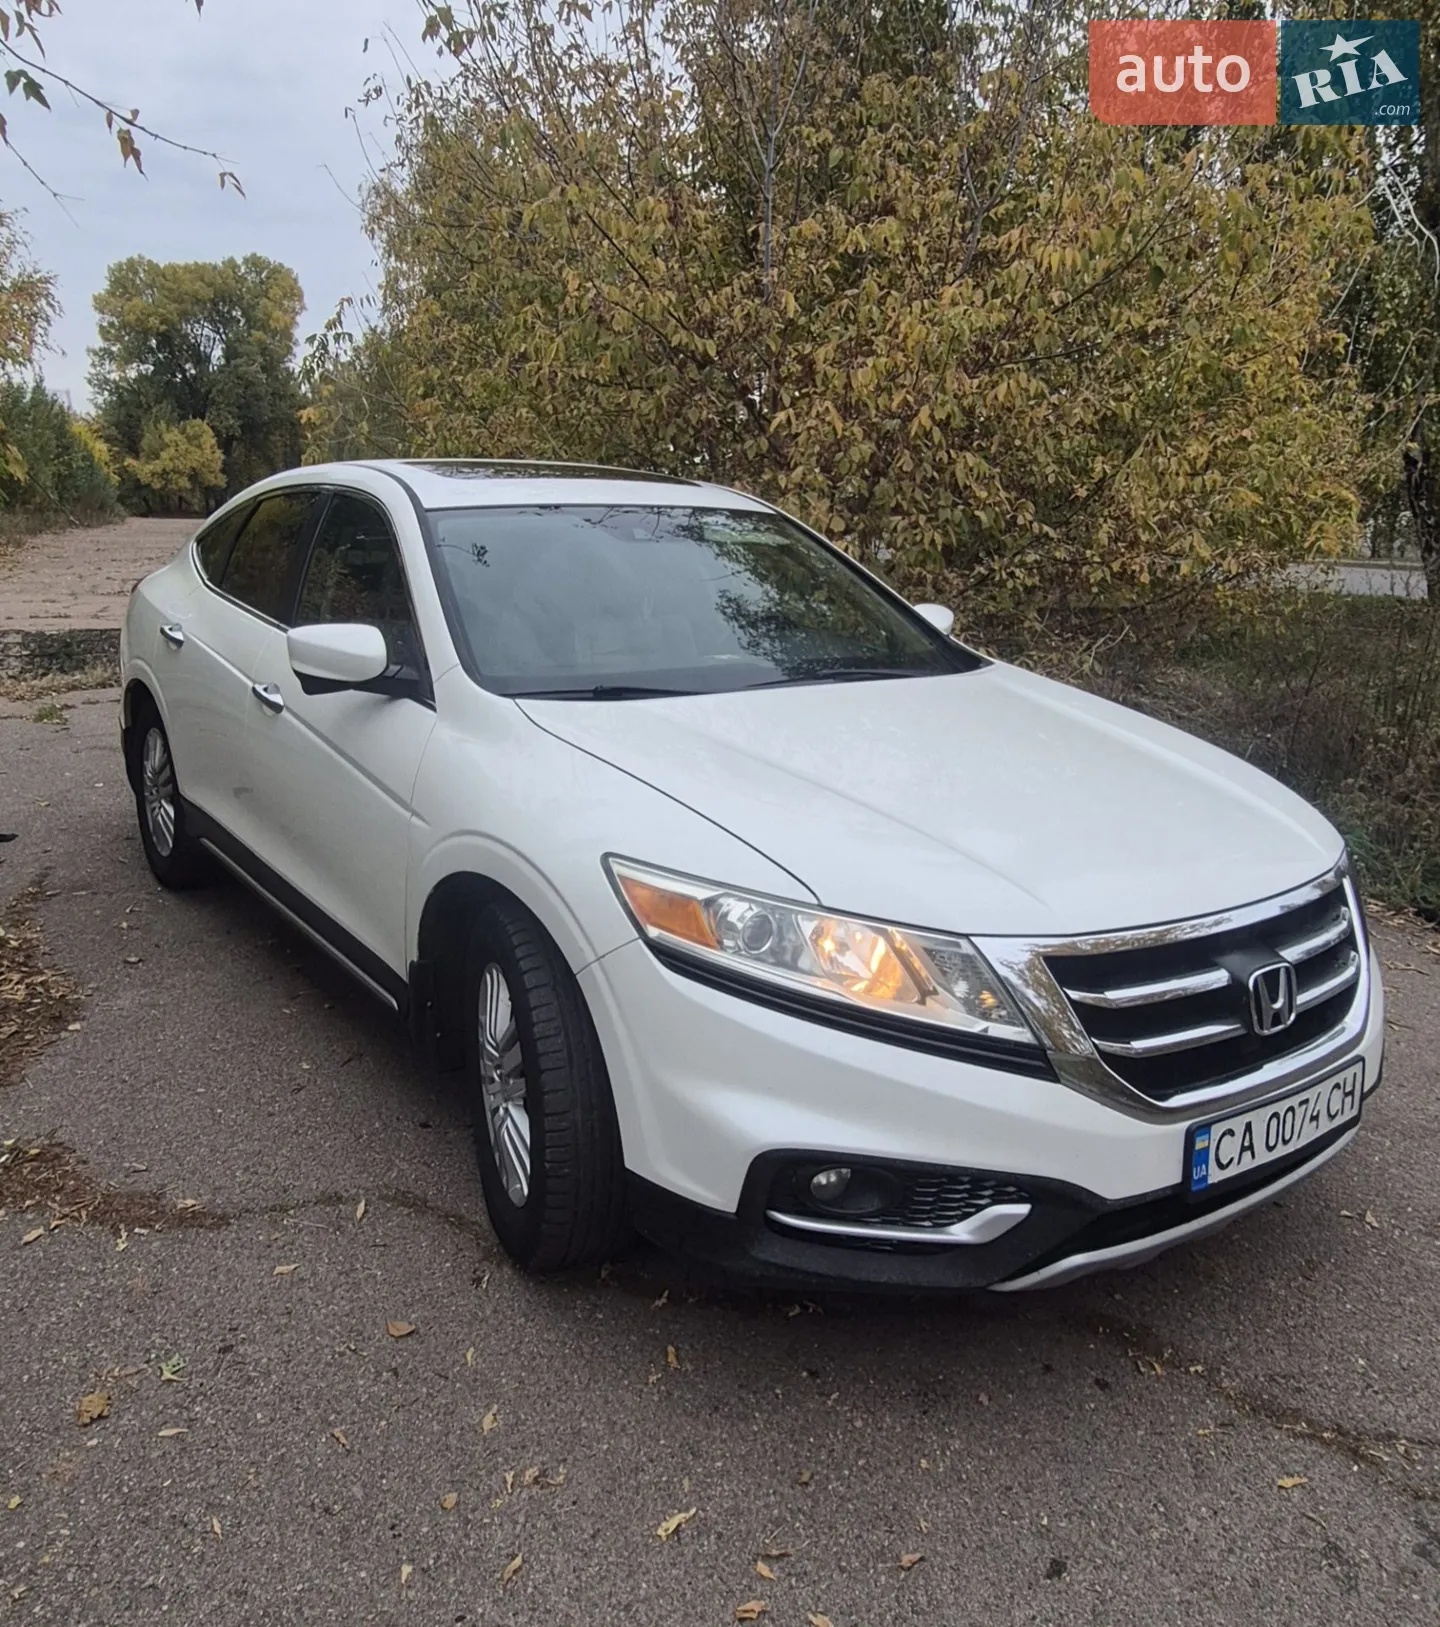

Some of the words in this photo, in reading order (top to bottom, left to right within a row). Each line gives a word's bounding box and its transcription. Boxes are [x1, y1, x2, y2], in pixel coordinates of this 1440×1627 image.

[1214, 1120, 1256, 1171] CA
[1265, 1091, 1322, 1152] 0074
[1326, 1072, 1357, 1121] CH
[1193, 1164, 1207, 1180] UA
